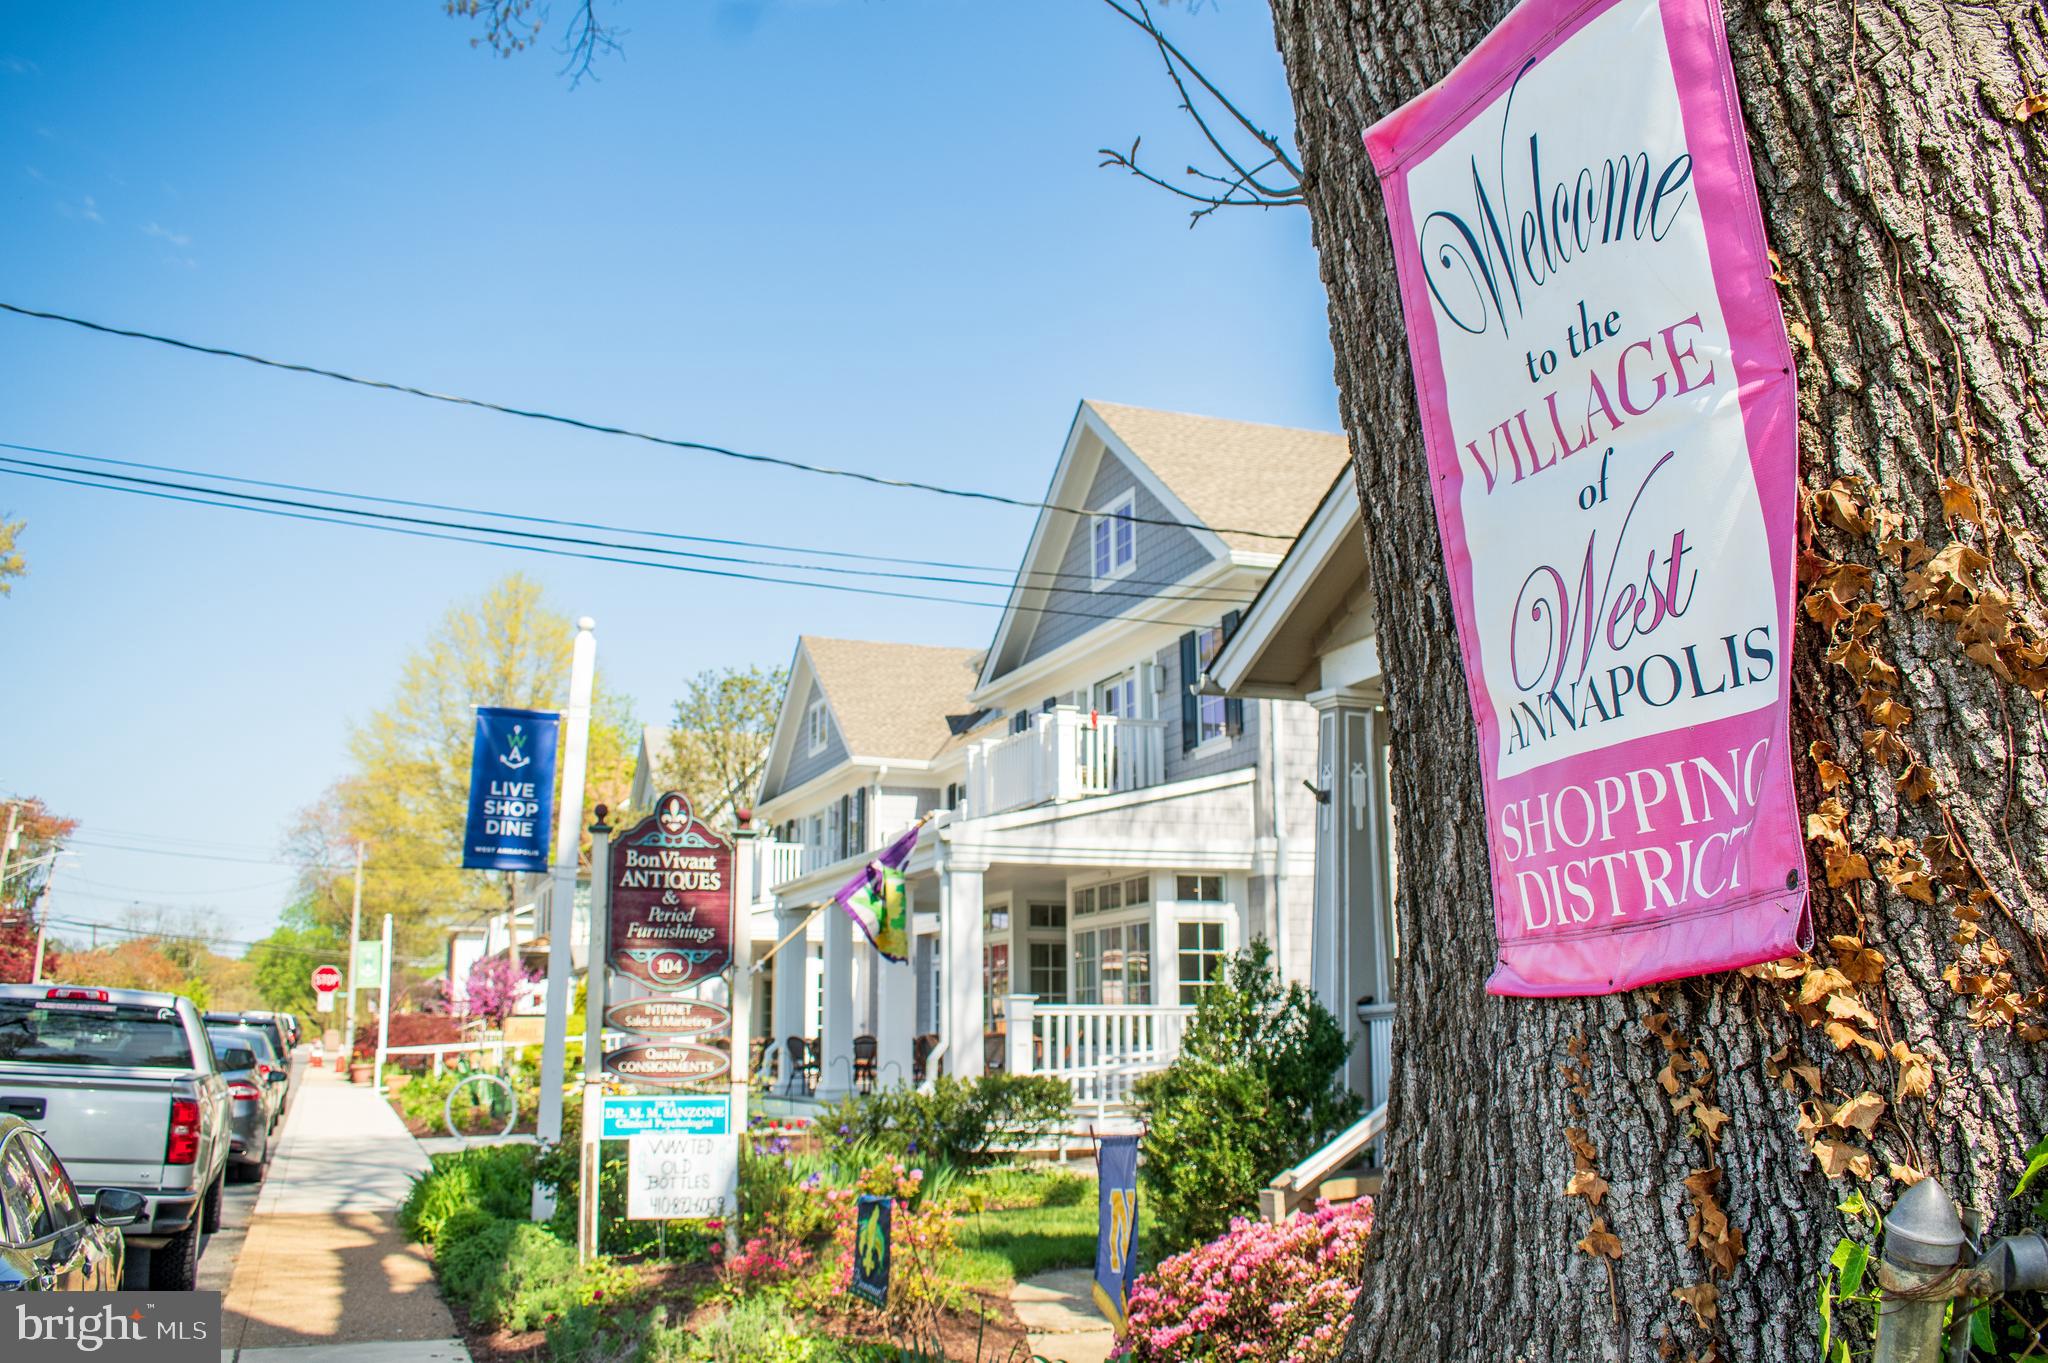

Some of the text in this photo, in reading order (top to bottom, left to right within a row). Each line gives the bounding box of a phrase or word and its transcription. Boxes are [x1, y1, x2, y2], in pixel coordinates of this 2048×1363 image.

[1420, 57, 1692, 340] Welcome
[1525, 300, 1621, 383] to the
[1466, 312, 1715, 495] VILLAGE
[1578, 447, 1614, 510] of
[1510, 451, 1698, 701] West
[1507, 625, 1774, 756] ANNAPOLIS
[490, 781, 535, 798] LIVE
[484, 800, 539, 817] SHOP
[485, 820, 533, 837] DINE
[619, 870, 722, 891] ANTIQUES
[1516, 820, 1753, 930] DISTRICT
[662, 890, 680, 905] &
[648, 907, 696, 923] Period
[627, 922, 715, 943] Furnishings
[656, 959, 684, 974] 104
[315, 974, 341, 986] STOP
[644, 1004, 693, 1015] INTERNET
[662, 1015, 712, 1029] Marketing
[645, 1048, 689, 1061] Quality
[618, 1061, 715, 1073] CONSIGNMENTS
[648, 1138, 714, 1154] WANTED
[661, 1158, 692, 1175] OLD
[644, 1174, 710, 1190] BOTTLES
